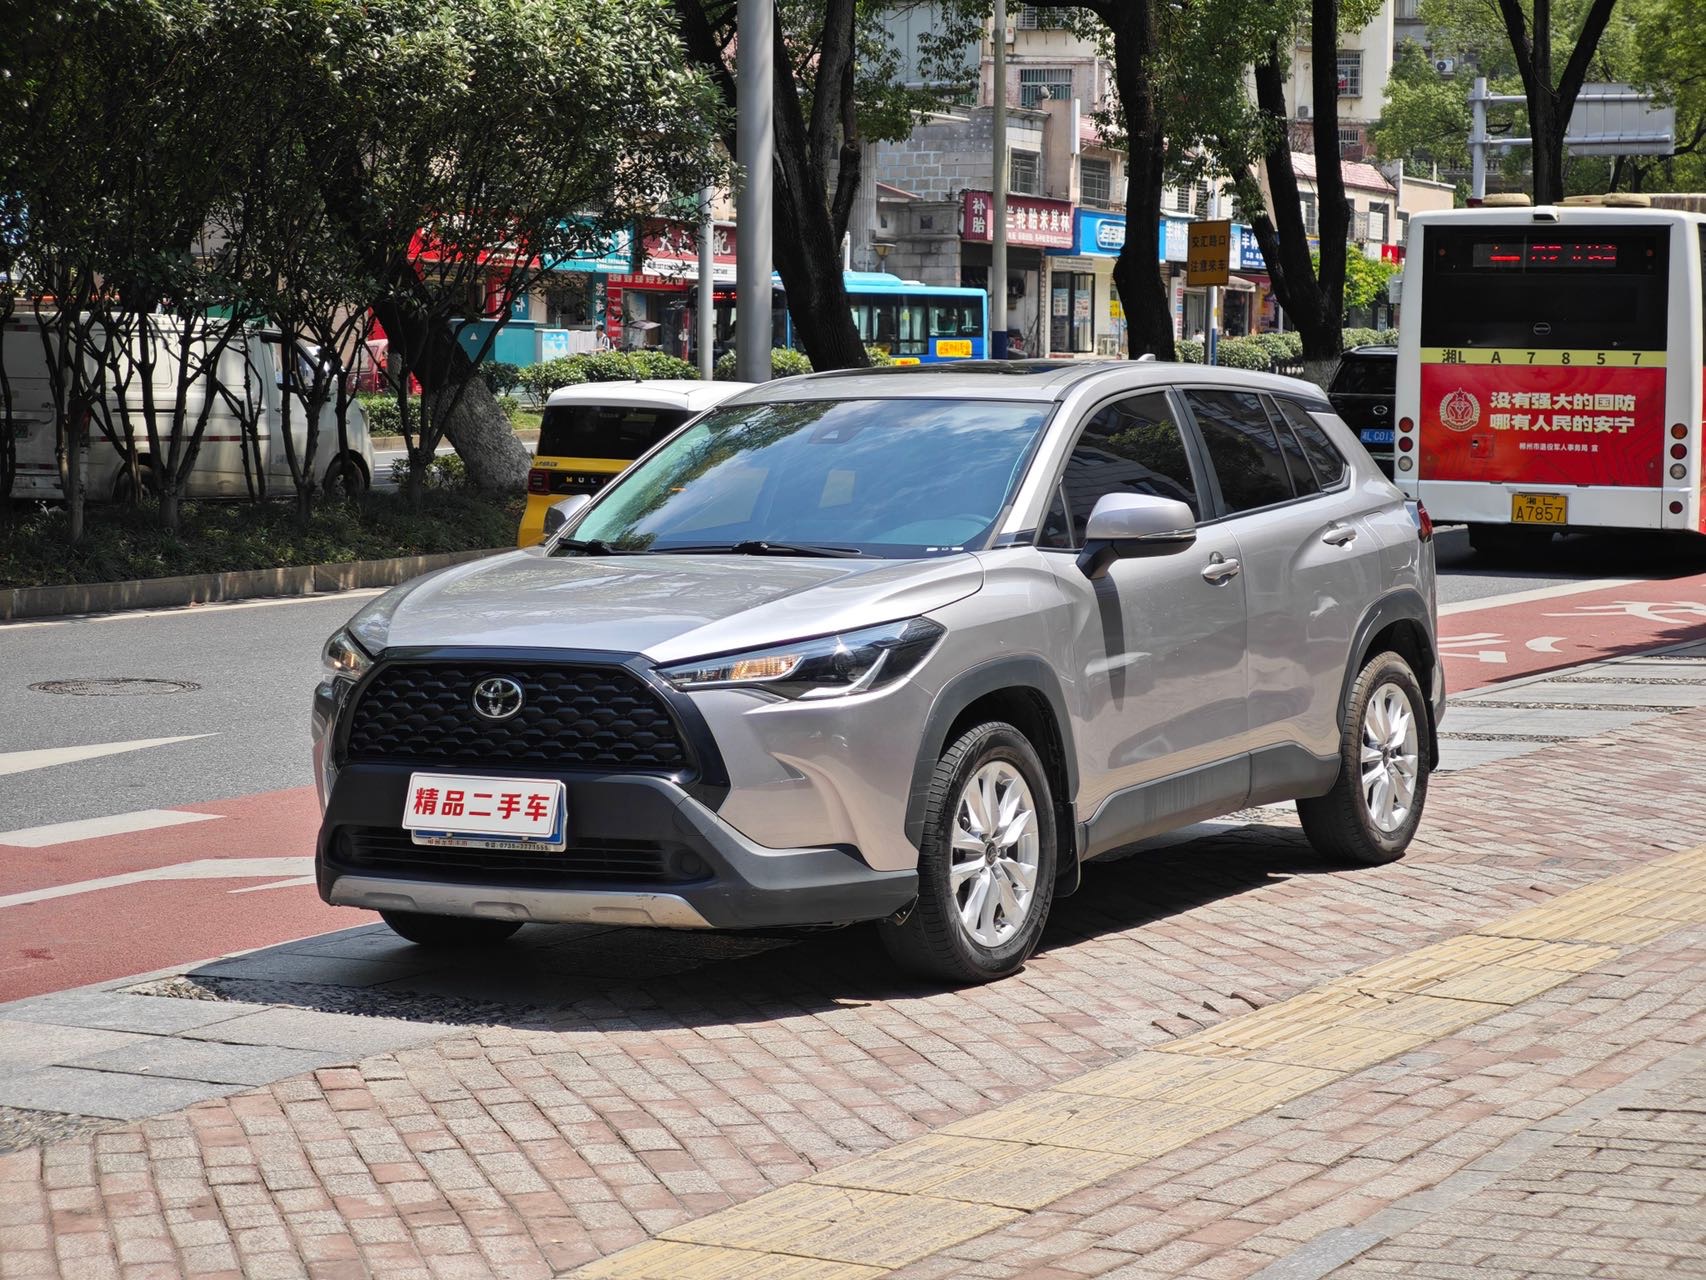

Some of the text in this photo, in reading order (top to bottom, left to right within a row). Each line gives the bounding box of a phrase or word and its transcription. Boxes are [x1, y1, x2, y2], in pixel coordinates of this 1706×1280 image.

[973, 198, 986, 233] 补胎
[1191, 235, 1226, 248] 交汇路口
[1191, 260, 1226, 272] 注意来车
[1441, 349, 1642, 365] 湘L A 7 8 5 7
[1490, 391, 1636, 412] 没有强大的国防
[1489, 413, 1635, 434] 哪有人民的安宁
[1516, 506, 1563, 521] A7857
[413, 787, 550, 821] 精品二手车
